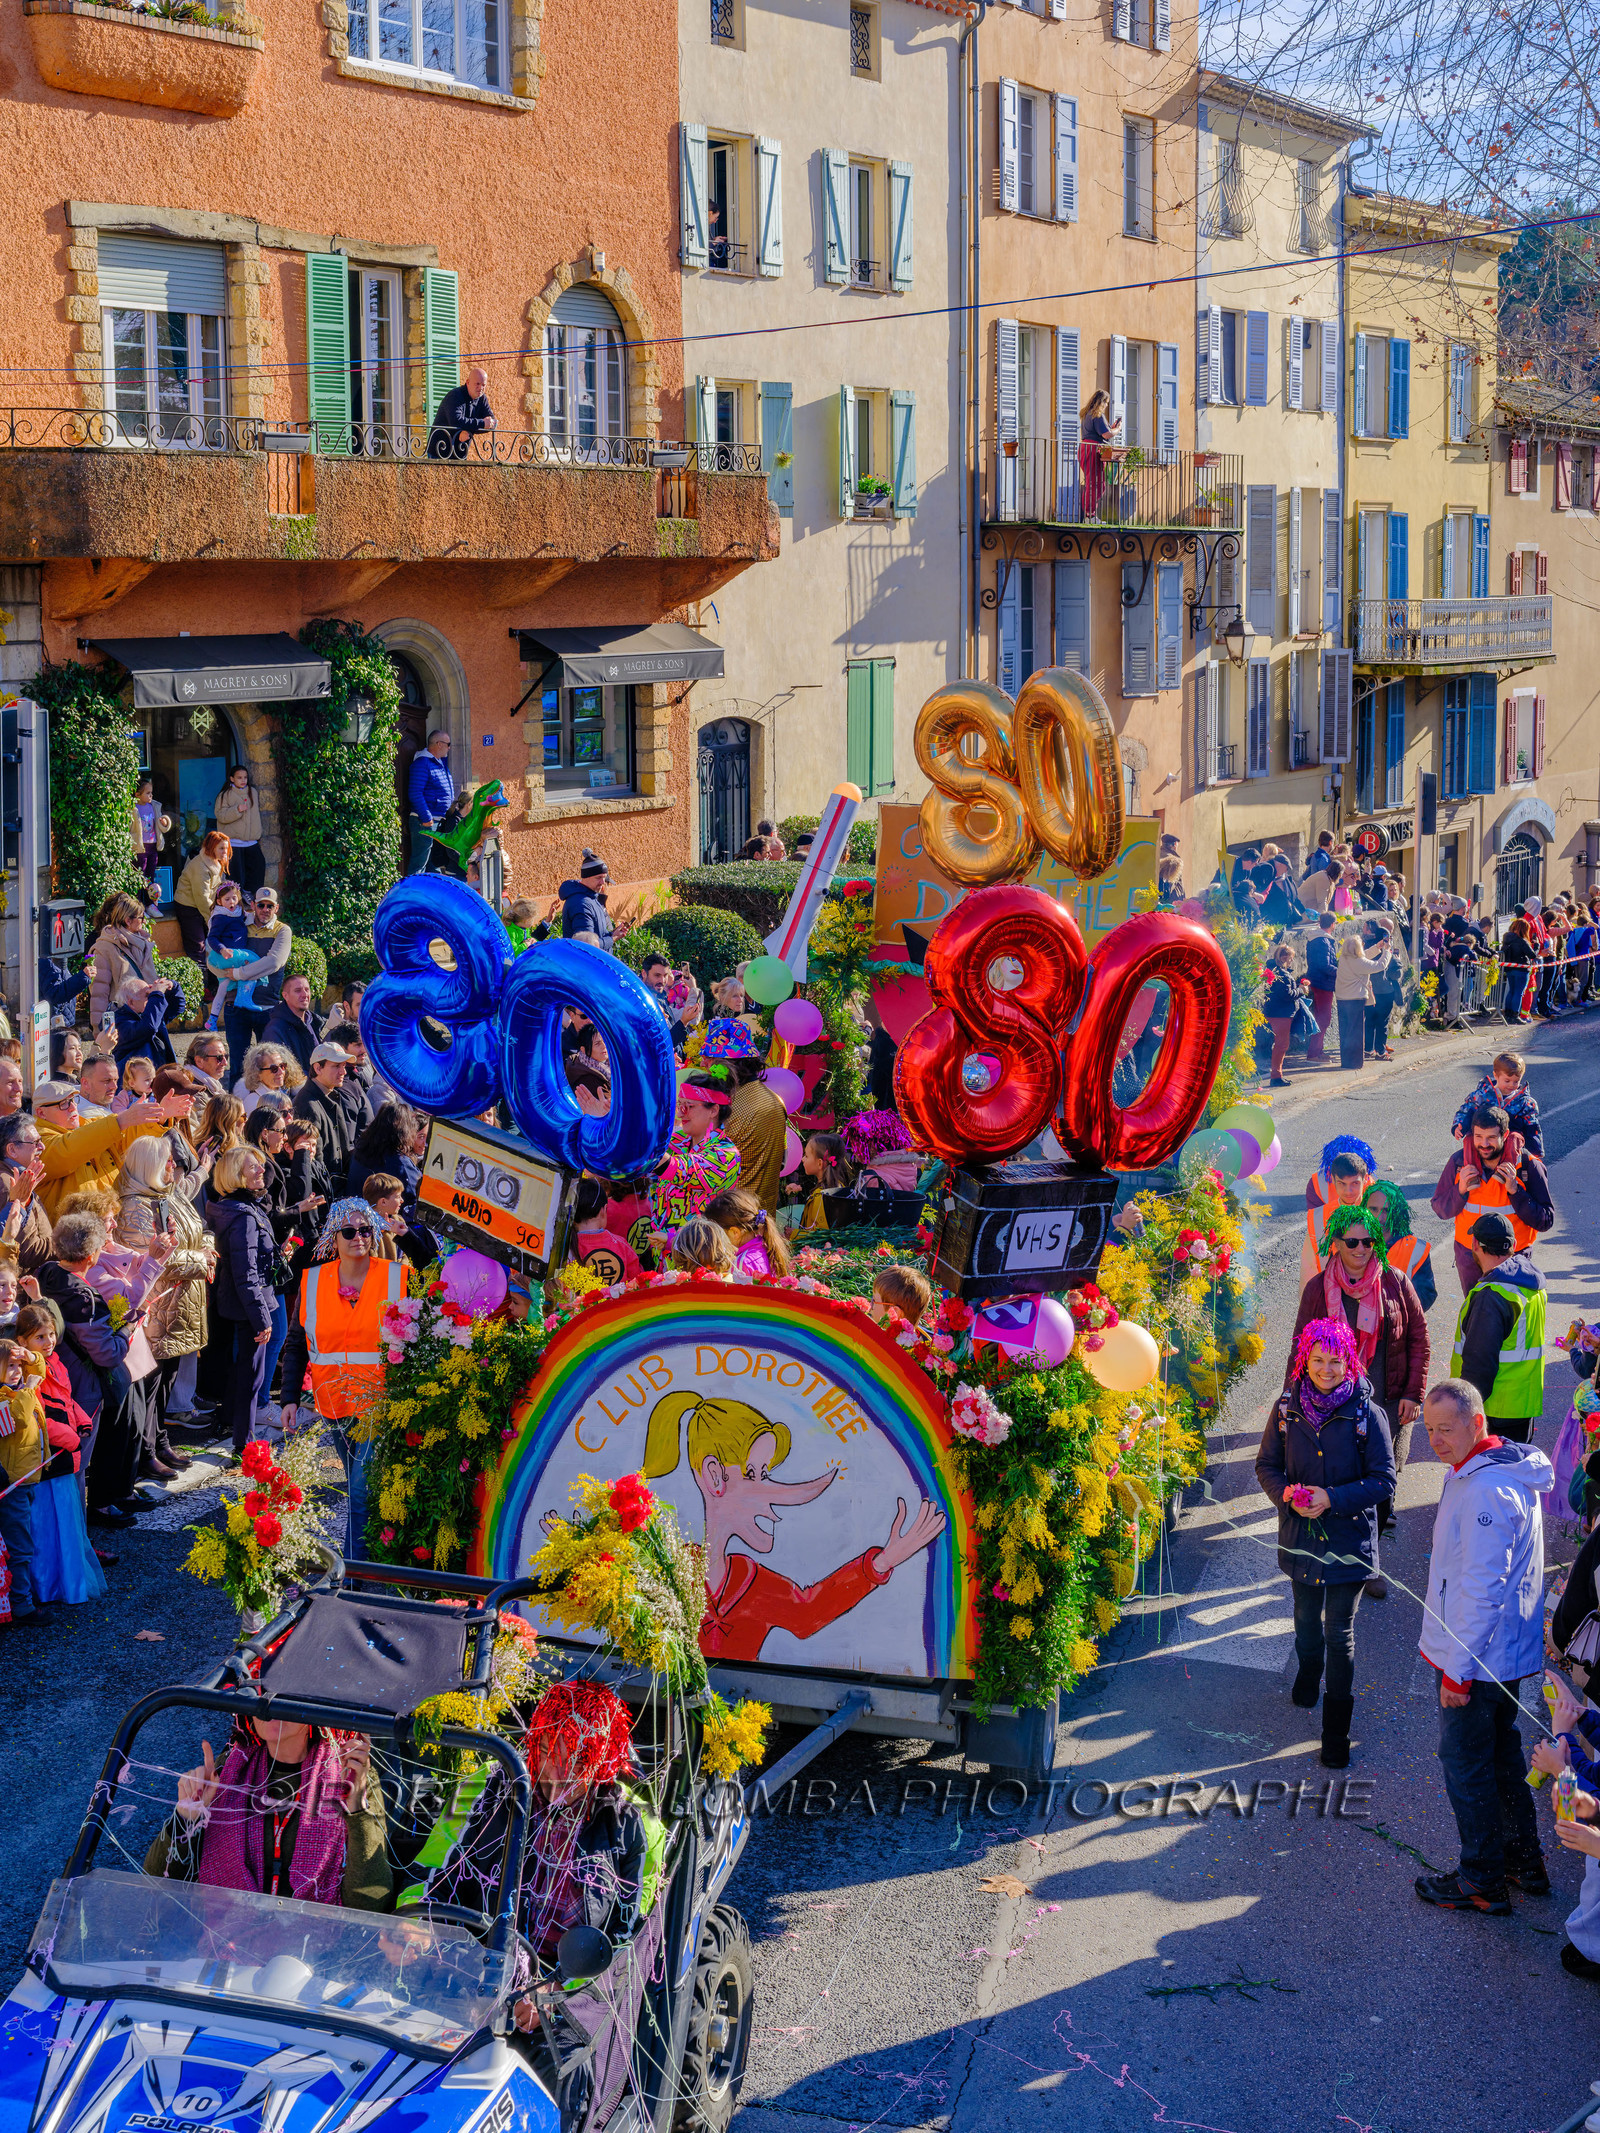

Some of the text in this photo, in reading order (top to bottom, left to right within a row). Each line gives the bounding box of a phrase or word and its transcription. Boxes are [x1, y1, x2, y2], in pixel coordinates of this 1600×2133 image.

[623, 658, 685, 672] MAGREY & SONS
[203, 674, 288, 689] MAGREY & SONS
[431, 1152, 444, 1171] A
[1016, 1223, 1062, 1253] VHS
[574, 1354, 674, 1453] CLUB
[182, 2094, 213, 2112] 10
[127, 2114, 233, 2133] POLAR
